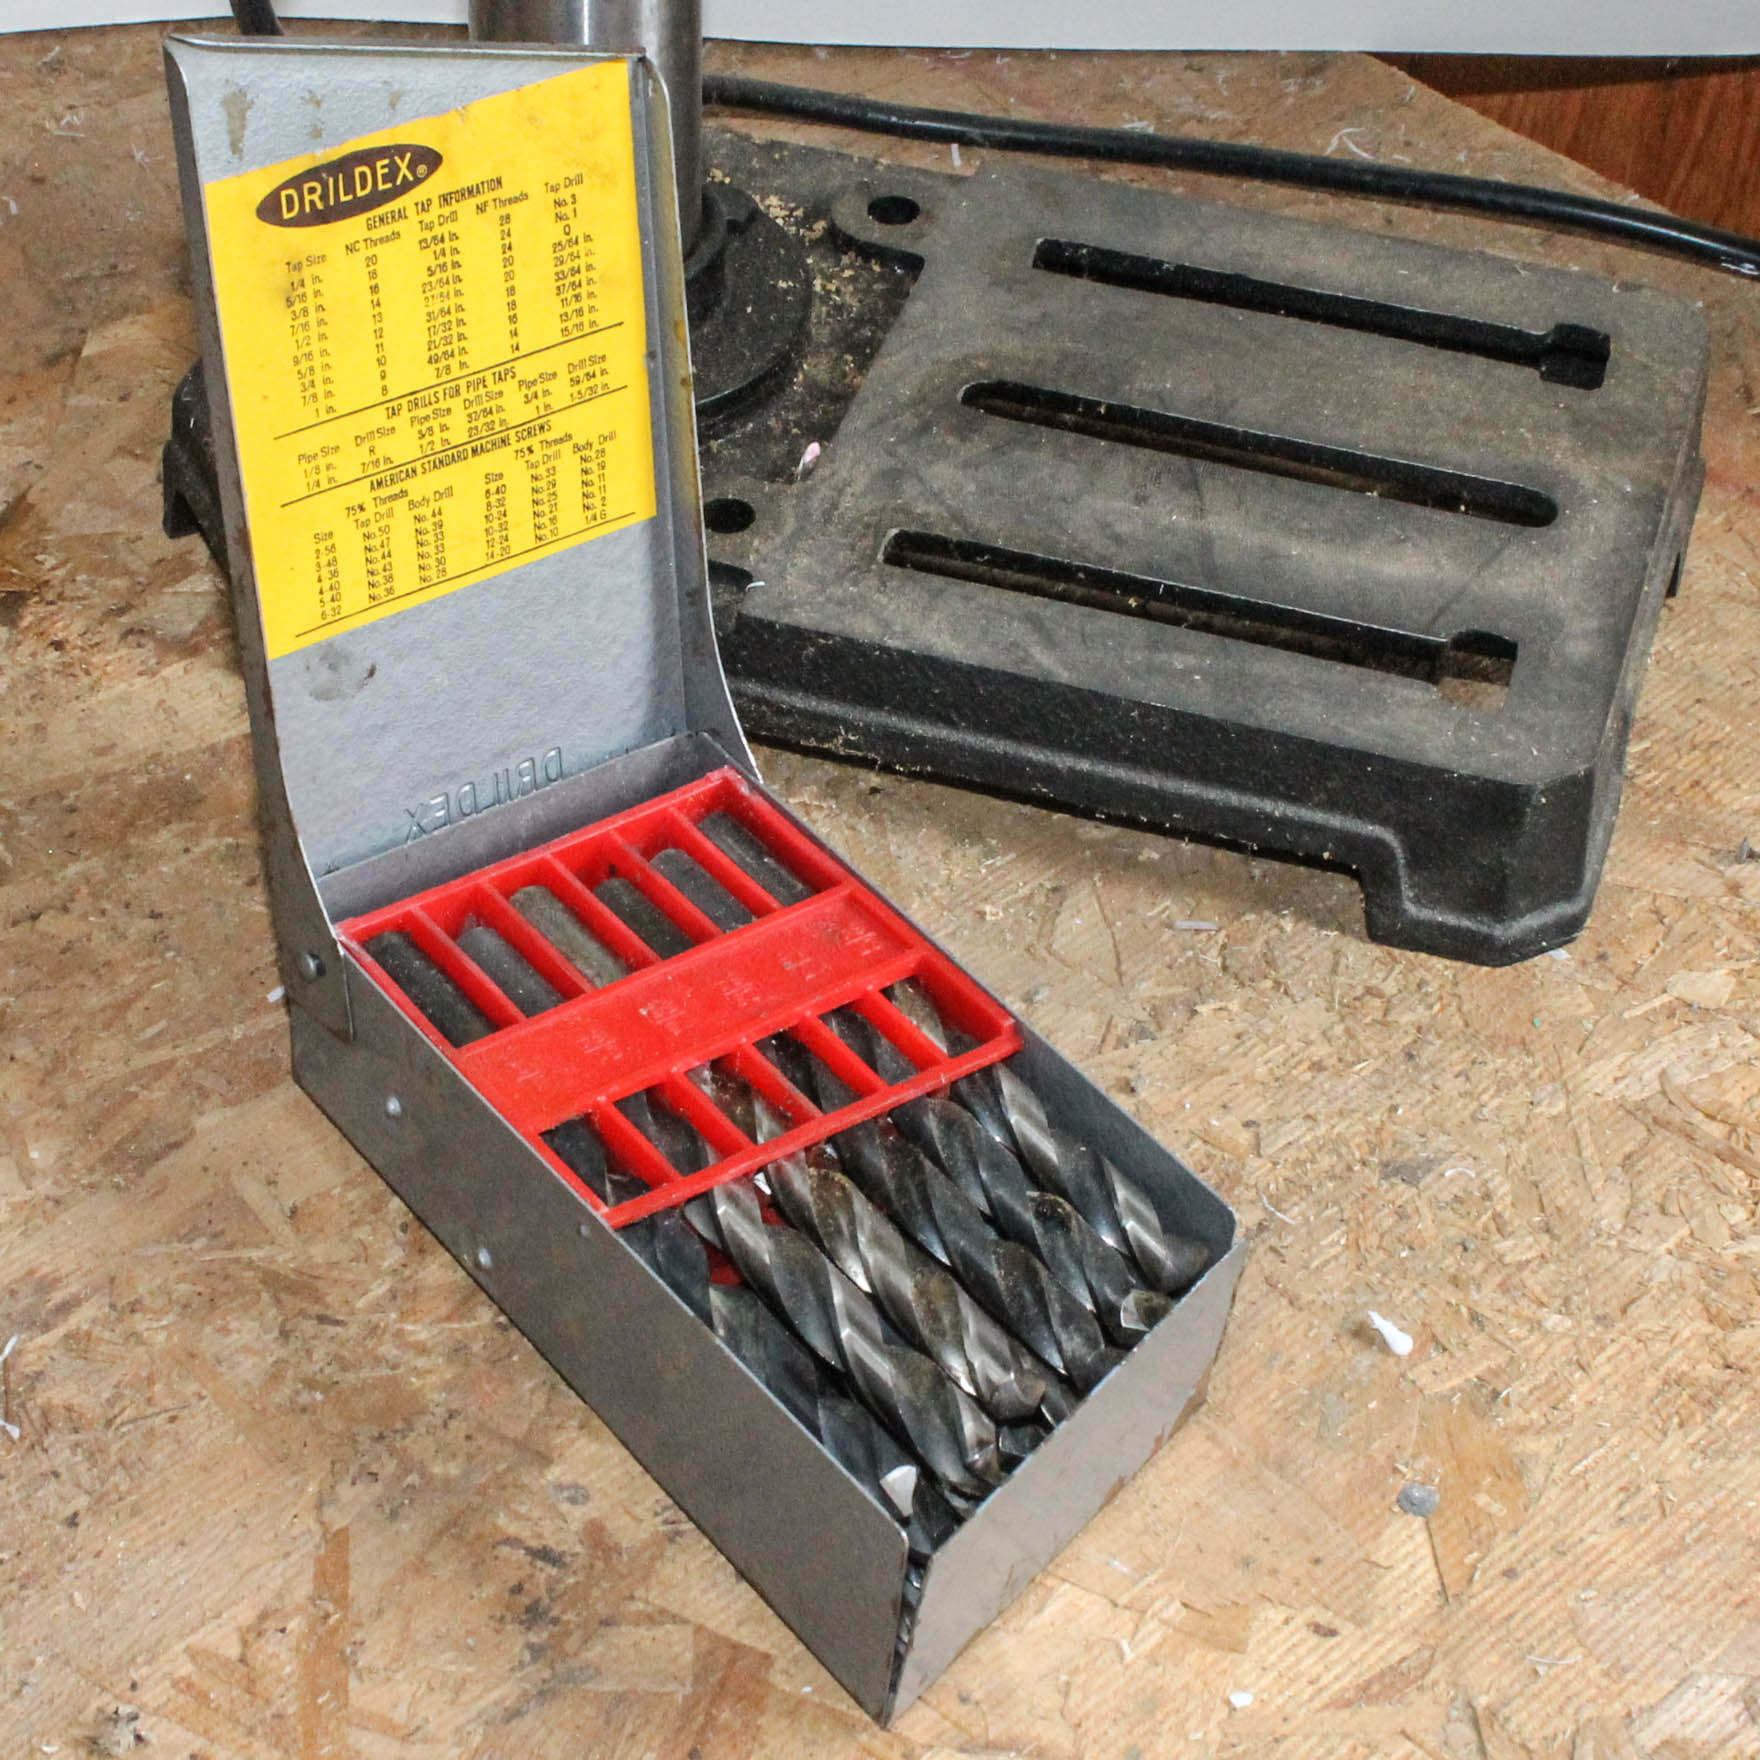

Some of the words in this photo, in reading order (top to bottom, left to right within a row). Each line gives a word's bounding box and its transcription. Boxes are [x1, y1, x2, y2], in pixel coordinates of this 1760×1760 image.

[280, 152, 413, 220] DRILDEX
[545, 181, 560, 194] Tap
[564, 172, 583, 189] Drill
[366, 207, 408, 231] GENERAL
[414, 198, 432, 216] TAP
[438, 176, 502, 208] INFORMATION
[476, 200, 488, 215] NF
[492, 189, 529, 210] Threads
[571, 193, 577, 205] 3
[418, 219, 435, 232] Tap
[438, 210, 458, 226] Drill
[500, 227, 511, 240] 24
[345, 240, 361, 256] NC
[363, 231, 401, 250] Threads
[501, 240, 512, 255] 24
[286, 261, 303, 273] Tap
[306, 254, 327, 267] Size
[365, 254, 378, 268] 20
[502, 255, 514, 268] 20
[504, 269, 514, 283] 20
[371, 297, 381, 311] 14
[291, 306, 309, 321] 3/8
[372, 311, 383, 325] 13
[290, 321, 310, 337] 7/16
[374, 327, 384, 340] 12
[509, 326, 518, 339] 14
[295, 335, 311, 351] 1/2
[376, 342, 384, 354] 11
[511, 341, 520, 354] 14
[293, 350, 314, 367] 9/16
[376, 354, 387, 368] 10
[567, 358, 587, 375] Drill
[588, 354, 606, 367] Size
[379, 369, 386, 380] 9
[435, 363, 452, 378] 7/8
[518, 378, 538, 392] Pipe
[539, 371, 558, 384] Size
[381, 384, 388, 397] 8
[385, 403, 402, 420] TAP
[407, 390, 440, 413] DRILLS
[443, 384, 461, 401] FOR
[466, 375, 488, 394] PIPE
[492, 366, 517, 385] TAPS
[301, 392, 318, 407] 7/8
[463, 393, 484, 410] Drill
[485, 390, 504, 403] Size
[410, 413, 431, 427] Pipe
[432, 407, 452, 420] Size
[354, 430, 375, 447] Drill
[376, 426, 396, 439] Size
[572, 438, 593, 454] Body
[598, 430, 616, 445] Drill
[420, 440, 435, 454] 1/2
[514, 445, 534, 460] 75%
[540, 431, 573, 451] Threads
[297, 452, 319, 465] Pipe
[320, 444, 340, 458] Size
[369, 466, 417, 492] AMERICAN
[420, 447, 469, 475] STANDARD
[470, 433, 512, 458] MACHINE
[515, 420, 552, 443] SCREWS
[525, 459, 540, 471] Tap
[542, 449, 561, 465] Drill
[484, 471, 504, 485] Size
[598, 472, 606, 483] 11
[306, 479, 321, 492] 1/4
[599, 484, 606, 495] 11
[345, 502, 366, 518] 75%
[372, 488, 409, 509] Threads
[408, 496, 431, 511] Body
[433, 485, 454, 502] Drill
[601, 496, 607, 507] 2
[431, 506, 443, 518] 44
[549, 502, 558, 514] 21
[354, 518, 371, 531] Tap
[374, 507, 394, 523] Drill
[313, 531, 334, 545] Size
[549, 526, 559, 538] 10
[380, 537, 391, 549] 47
[381, 548, 392, 560] 44
